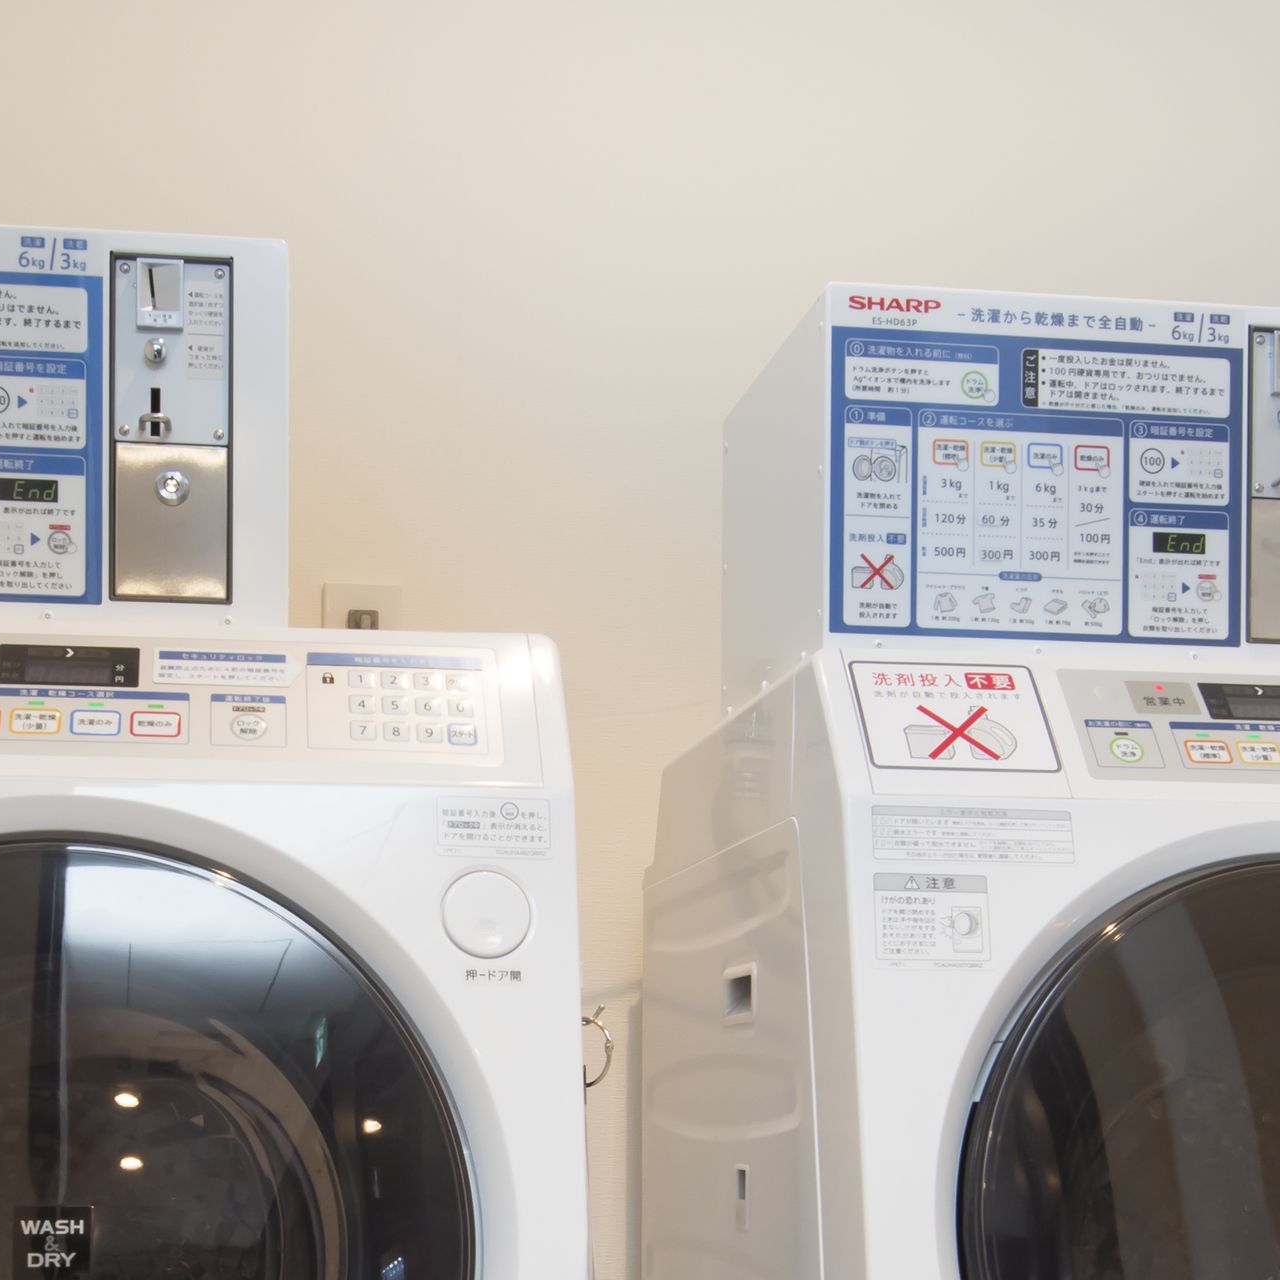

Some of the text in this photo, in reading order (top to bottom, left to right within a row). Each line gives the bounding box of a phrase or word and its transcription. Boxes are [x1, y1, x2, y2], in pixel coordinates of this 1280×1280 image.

[849, 296, 941, 313] SHARP
[872, 317, 917, 327] ES-HD63P
[1025, 354, 1037, 400] ご注意
[1144, 456, 1161, 466] 100
[13, 481, 55, 500] End
[1150, 514, 1185, 525] 運転終了
[849, 533, 884, 542] 洗剤投入
[1167, 535, 1203, 552] End
[115, 664, 125, 672] 分
[358, 675, 362, 683] 1
[390, 677, 397, 685] 2
[423, 677, 429, 686] 3
[872, 672, 1013, 689] 洗剤投入 不要
[358, 700, 365, 708] 4
[391, 702, 398, 710] 5
[424, 702, 431, 711] 6
[138, 720, 173, 728] 乾燥のみ
[360, 726, 366, 735] 7
[393, 727, 400, 736] 8
[426, 728, 433, 737] 9
[926, 877, 956, 889] 注意
[20, 1220, 84, 1234] WASH
[44, 1235, 60, 1252] &
[27, 1253, 76, 1267] DRY
